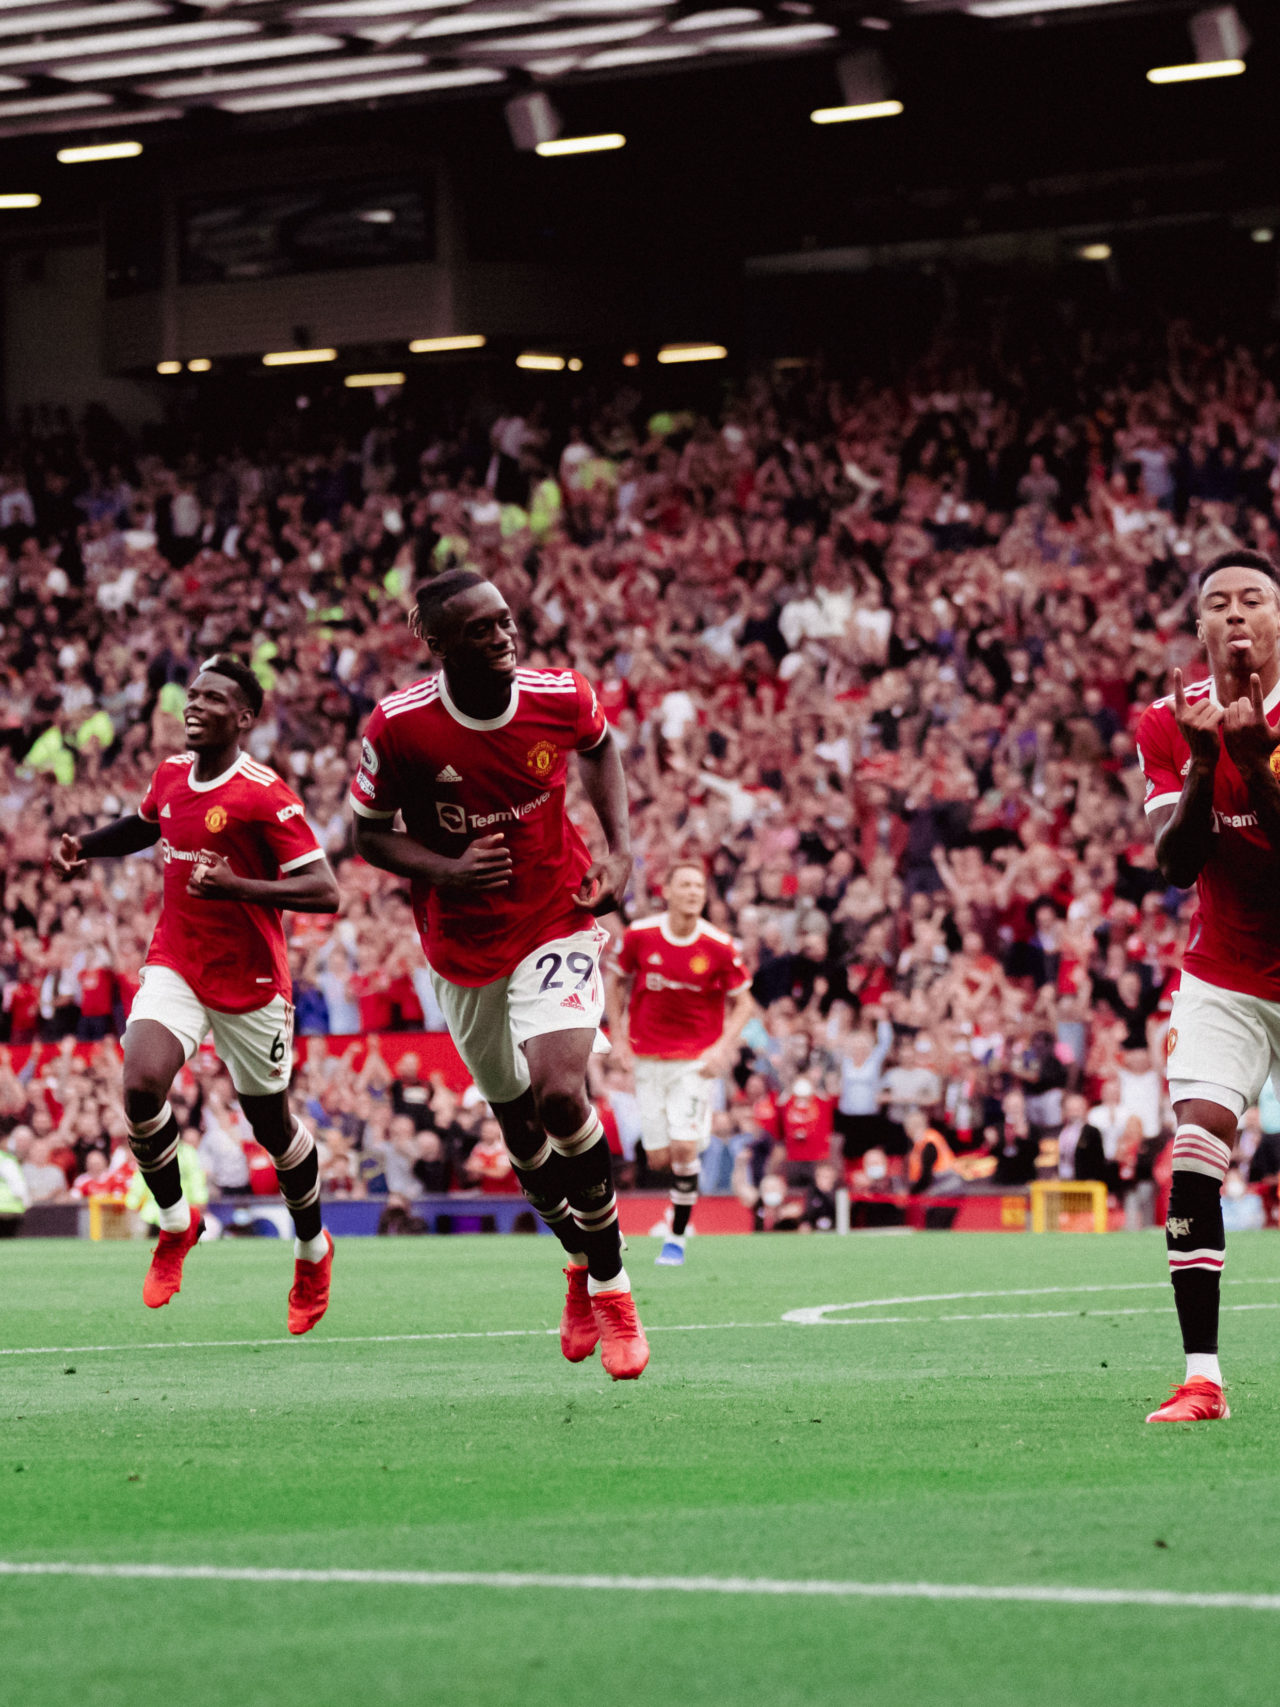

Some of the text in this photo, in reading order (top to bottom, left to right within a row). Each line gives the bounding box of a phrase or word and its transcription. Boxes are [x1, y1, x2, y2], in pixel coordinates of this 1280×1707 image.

[1216, 810, 1257, 828] Team
[536, 951, 594, 994] 29
[270, 1030, 285, 1063] 6
